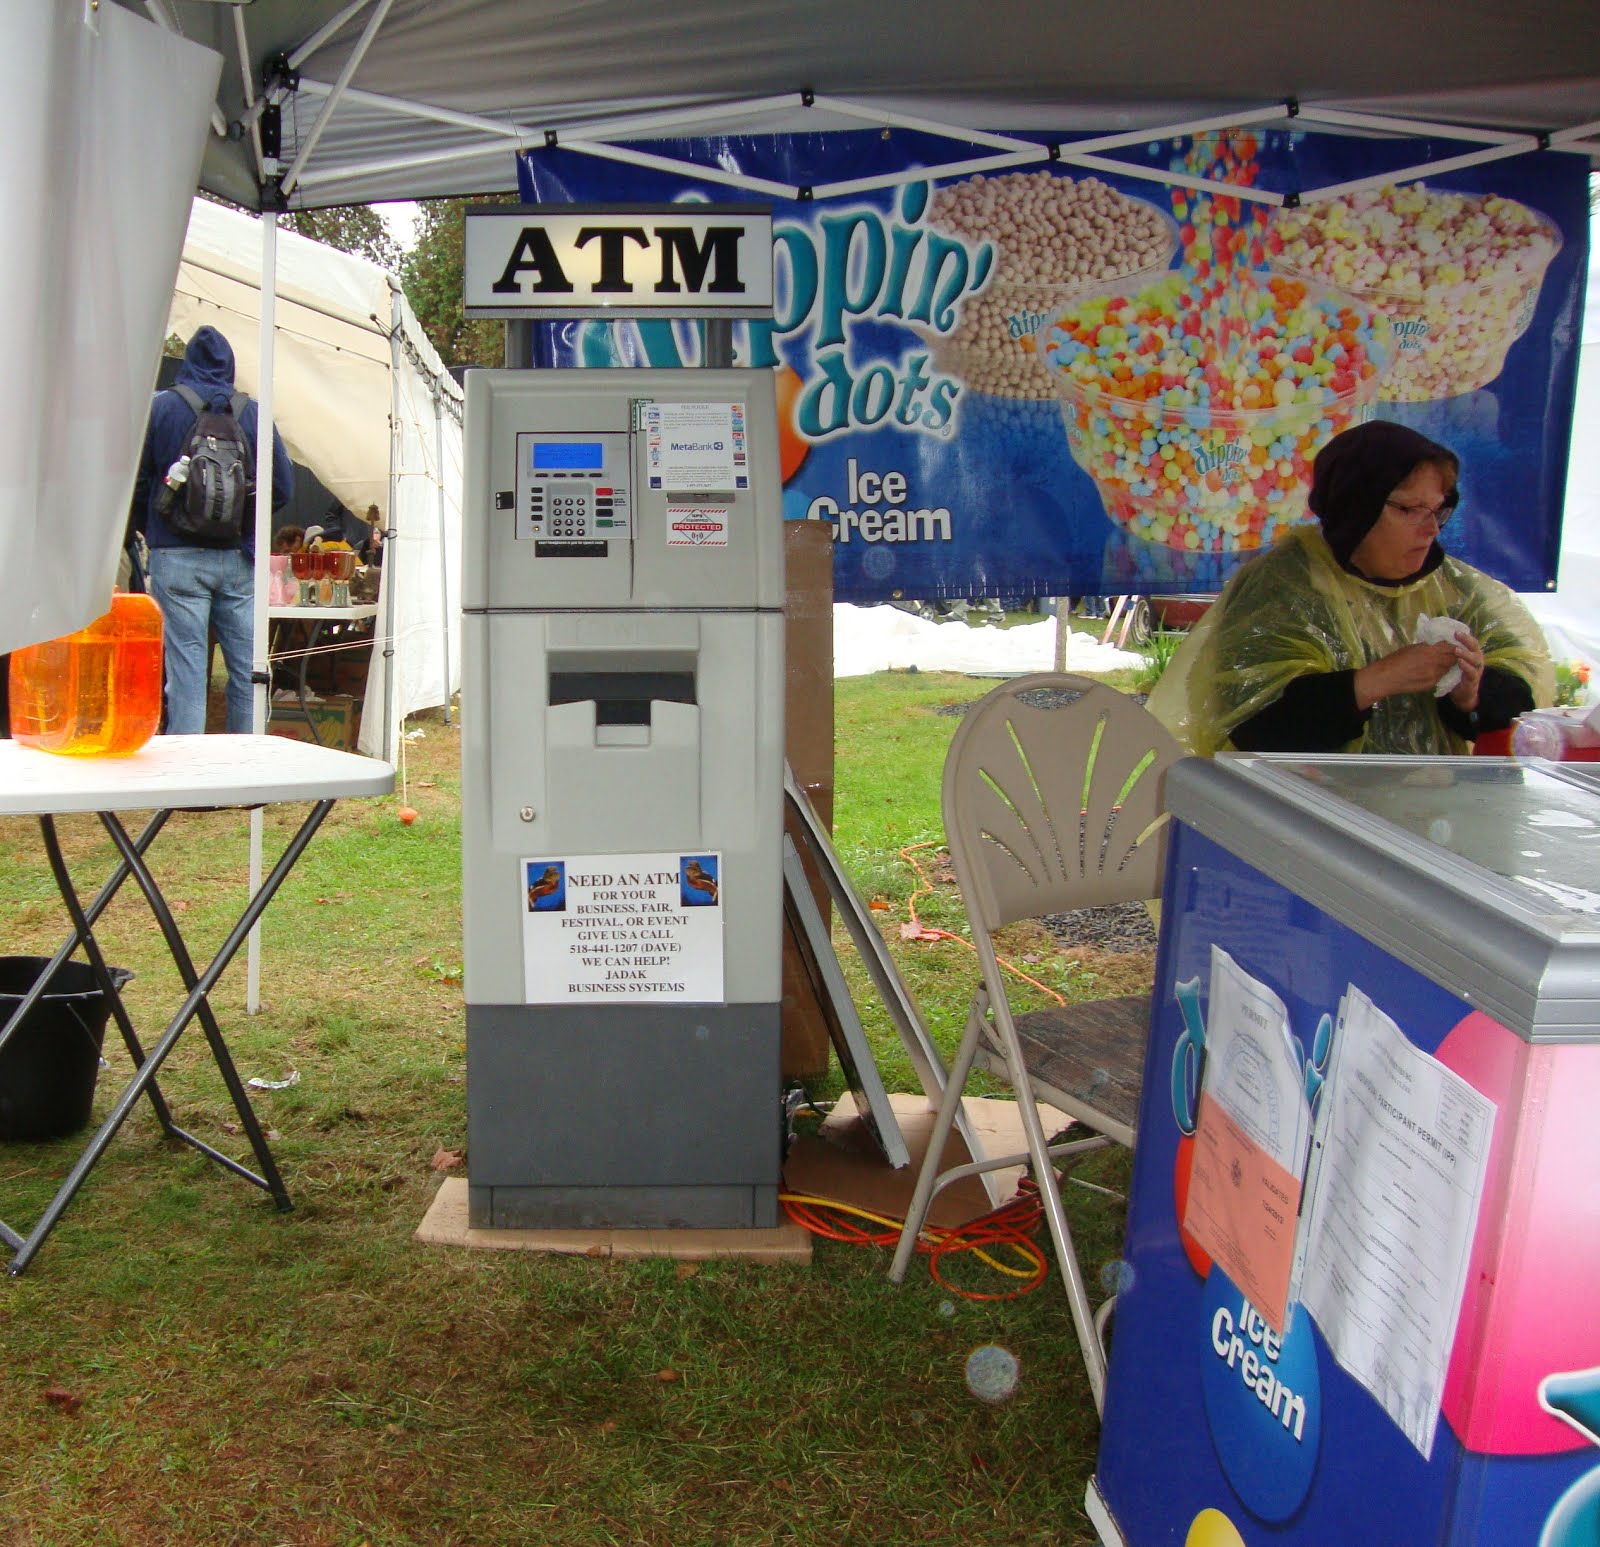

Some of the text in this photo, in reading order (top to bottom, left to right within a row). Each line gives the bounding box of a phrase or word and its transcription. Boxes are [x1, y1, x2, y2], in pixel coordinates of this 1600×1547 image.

[492, 227, 746, 293] ATM
[799, 350, 959, 437] dots
[670, 442, 713, 451] MetaBank
[848, 458, 907, 504] Ice
[807, 497, 952, 543] Cream
[568, 872, 680, 888] NEED AN ATM
[593, 890, 656, 900] FOR YOUR
[577, 904, 673, 914] BUSINESS, FAIR,
[561, 916, 689, 928] FESTIVAL, OR EVENT
[578, 930, 673, 940] GIVE US A CALL
[569, 943, 681, 953] 518-441-1207 (DAVE)
[582, 956, 670, 966] WE CAN HELP!
[605, 970, 647, 980] JADAK
[569, 983, 685, 993] BUSINESS SYSTEMS
[1378, 1094, 1416, 1133] PARTICIPANT
[1416, 1126, 1442, 1153] PERMIT
[1211, 1306, 1306, 1442] Cream
